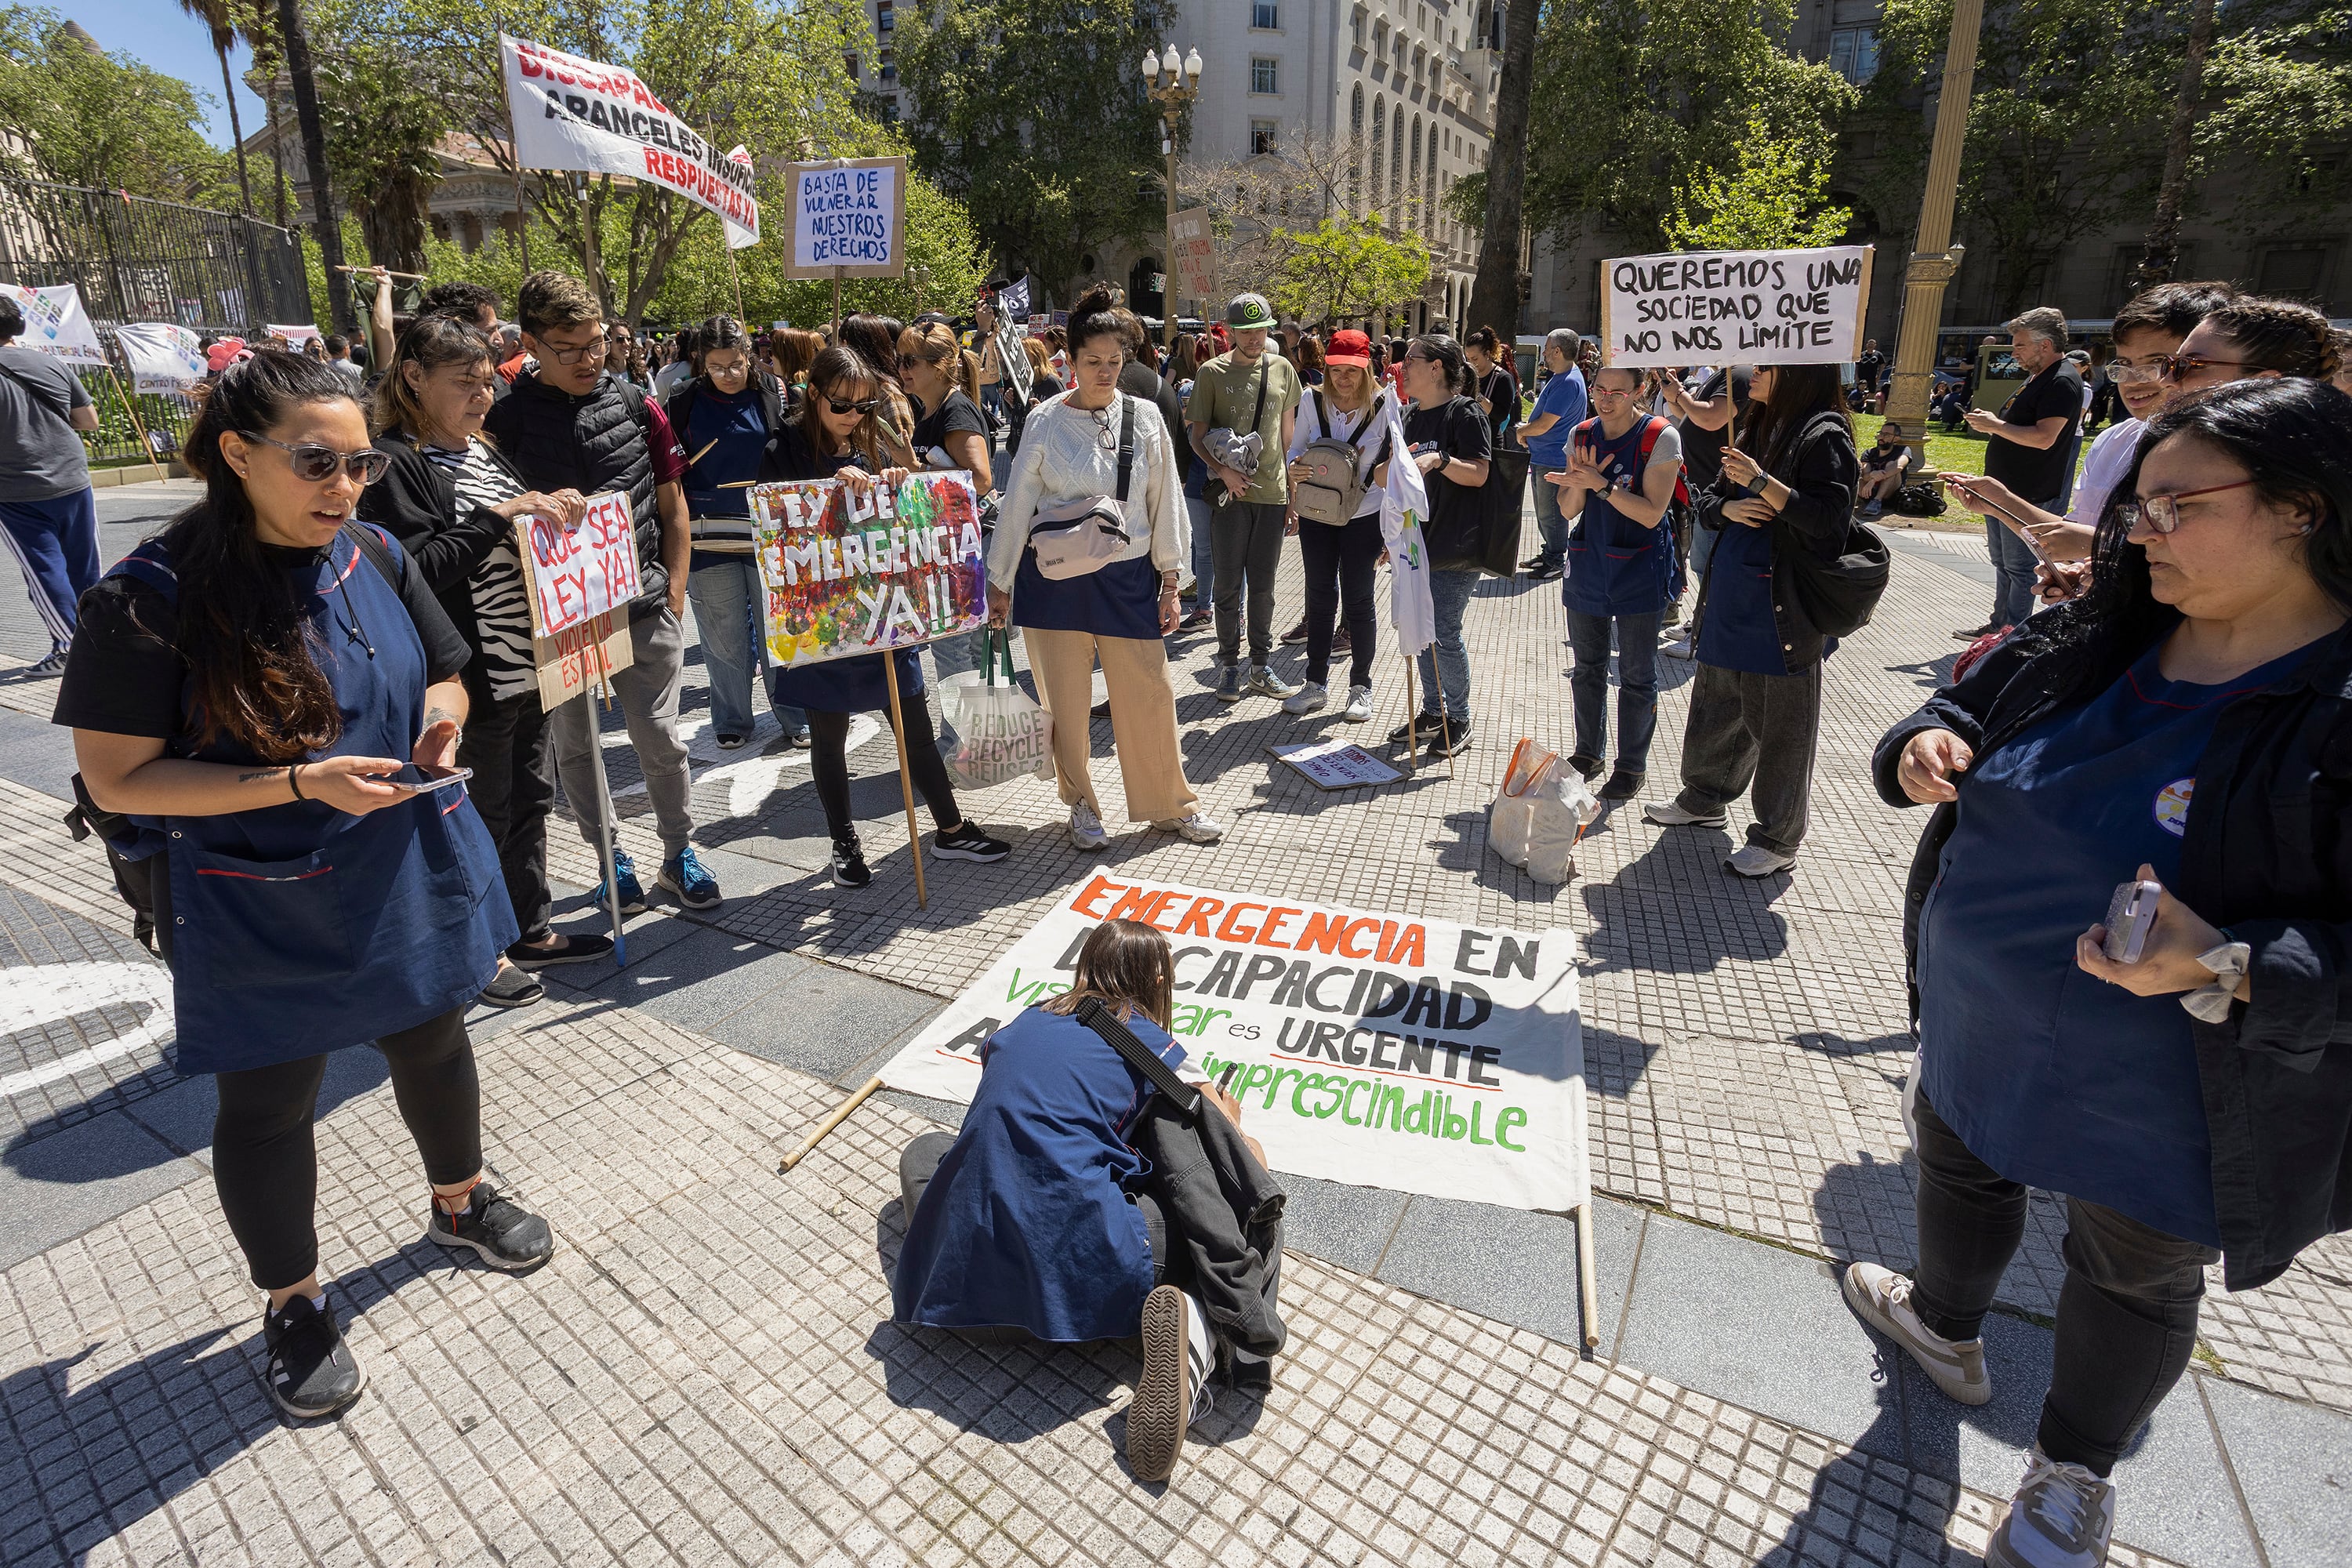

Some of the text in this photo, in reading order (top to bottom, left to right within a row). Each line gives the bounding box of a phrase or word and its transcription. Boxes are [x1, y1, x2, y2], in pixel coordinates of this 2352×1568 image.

[545, 89, 703, 160] ARANCELES
[643, 147, 754, 230] RESPUESTAS YA
[804, 171, 878, 195] BASTA DE
[804, 194, 879, 213] VULNERAR
[812, 213, 885, 238] NUESTROS
[814, 238, 887, 262] DERECHOS
[1613, 258, 1862, 296] QUEREMOS UNA
[1777, 291, 1830, 321] QUE
[1624, 330, 1661, 353] NO
[1671, 325, 1722, 351] NOS
[757, 481, 894, 532] LEY DE
[530, 499, 630, 568] QUE SEA
[539, 539, 638, 633] LEY YA!
[855, 574, 952, 646] YA!!
[971, 710, 1044, 738] REDUCE
[969, 734, 1044, 762] RECYCLE
[1069, 875, 1539, 981] EMERGENCIA EN
[1054, 927, 1492, 1030] DCAPACIDAD
[1229, 1021, 1261, 1040] es
[1276, 1017, 1501, 1087] URGENTE
